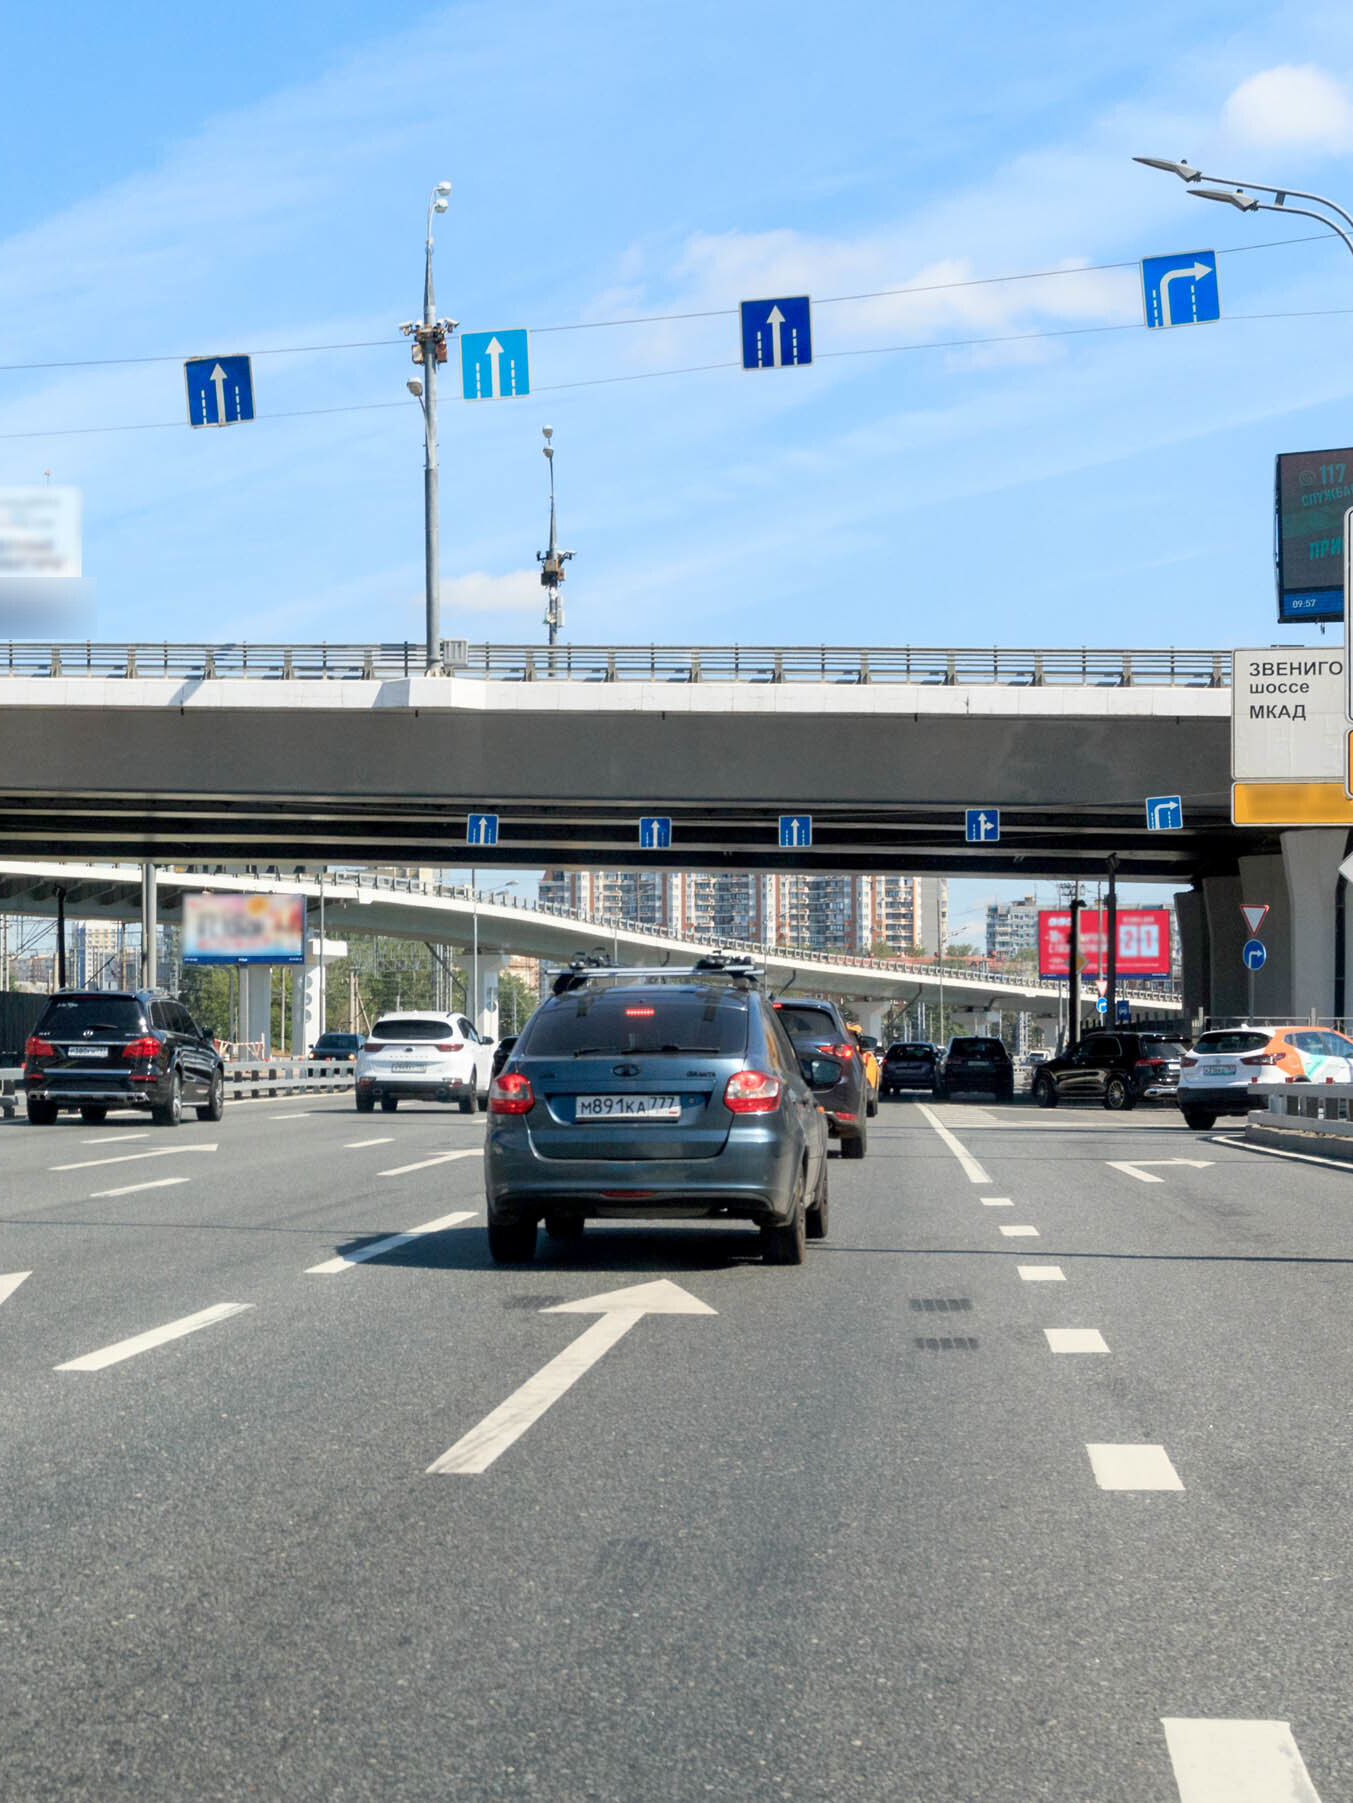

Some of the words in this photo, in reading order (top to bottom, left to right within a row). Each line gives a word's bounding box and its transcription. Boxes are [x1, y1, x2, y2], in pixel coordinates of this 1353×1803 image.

[1319, 463, 1346, 486] 117
[1301, 484, 1353, 507] СЛУЖБА
[1309, 535, 1345, 561] ПРИ
[1292, 599, 1316, 608] 09:57
[1249, 661, 1343, 676] ЗВЕНИГО
[1249, 682, 1310, 694] шоссе
[1250, 704, 1306, 721] МКАД
[580, 1098, 646, 1115] М891КА
[650, 1096, 675, 1110] 777
